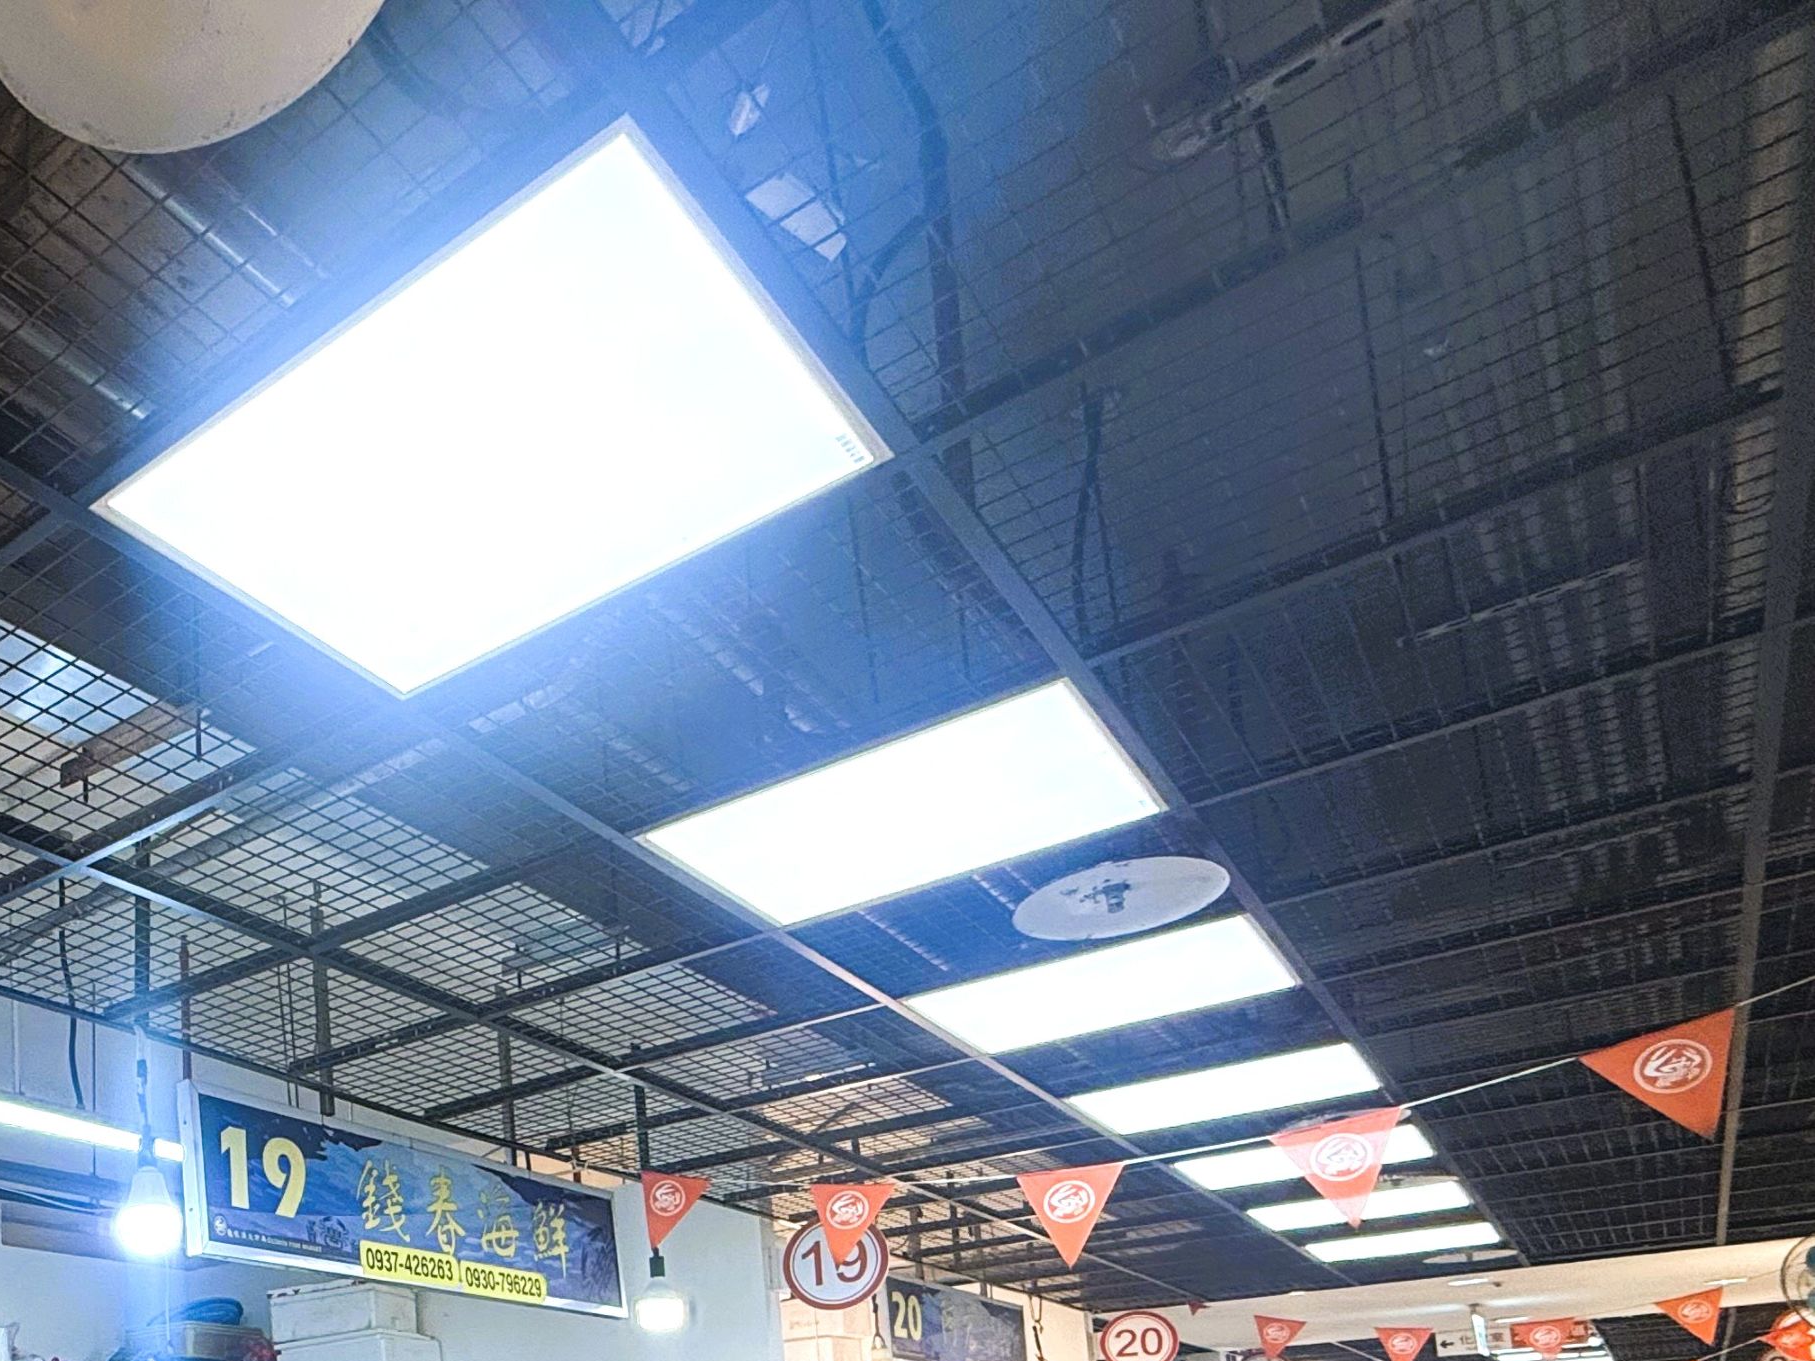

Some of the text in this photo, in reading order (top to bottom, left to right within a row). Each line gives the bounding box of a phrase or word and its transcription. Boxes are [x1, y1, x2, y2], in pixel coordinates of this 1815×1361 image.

[220, 1125, 307, 1218] 19
[365, 1247, 454, 1281] 0937-426263
[465, 1266, 542, 1298] 0930-796229
[801, 1239, 868, 1287] 19
[892, 1291, 923, 1341] 20
[1115, 1328, 1163, 1357] 20
